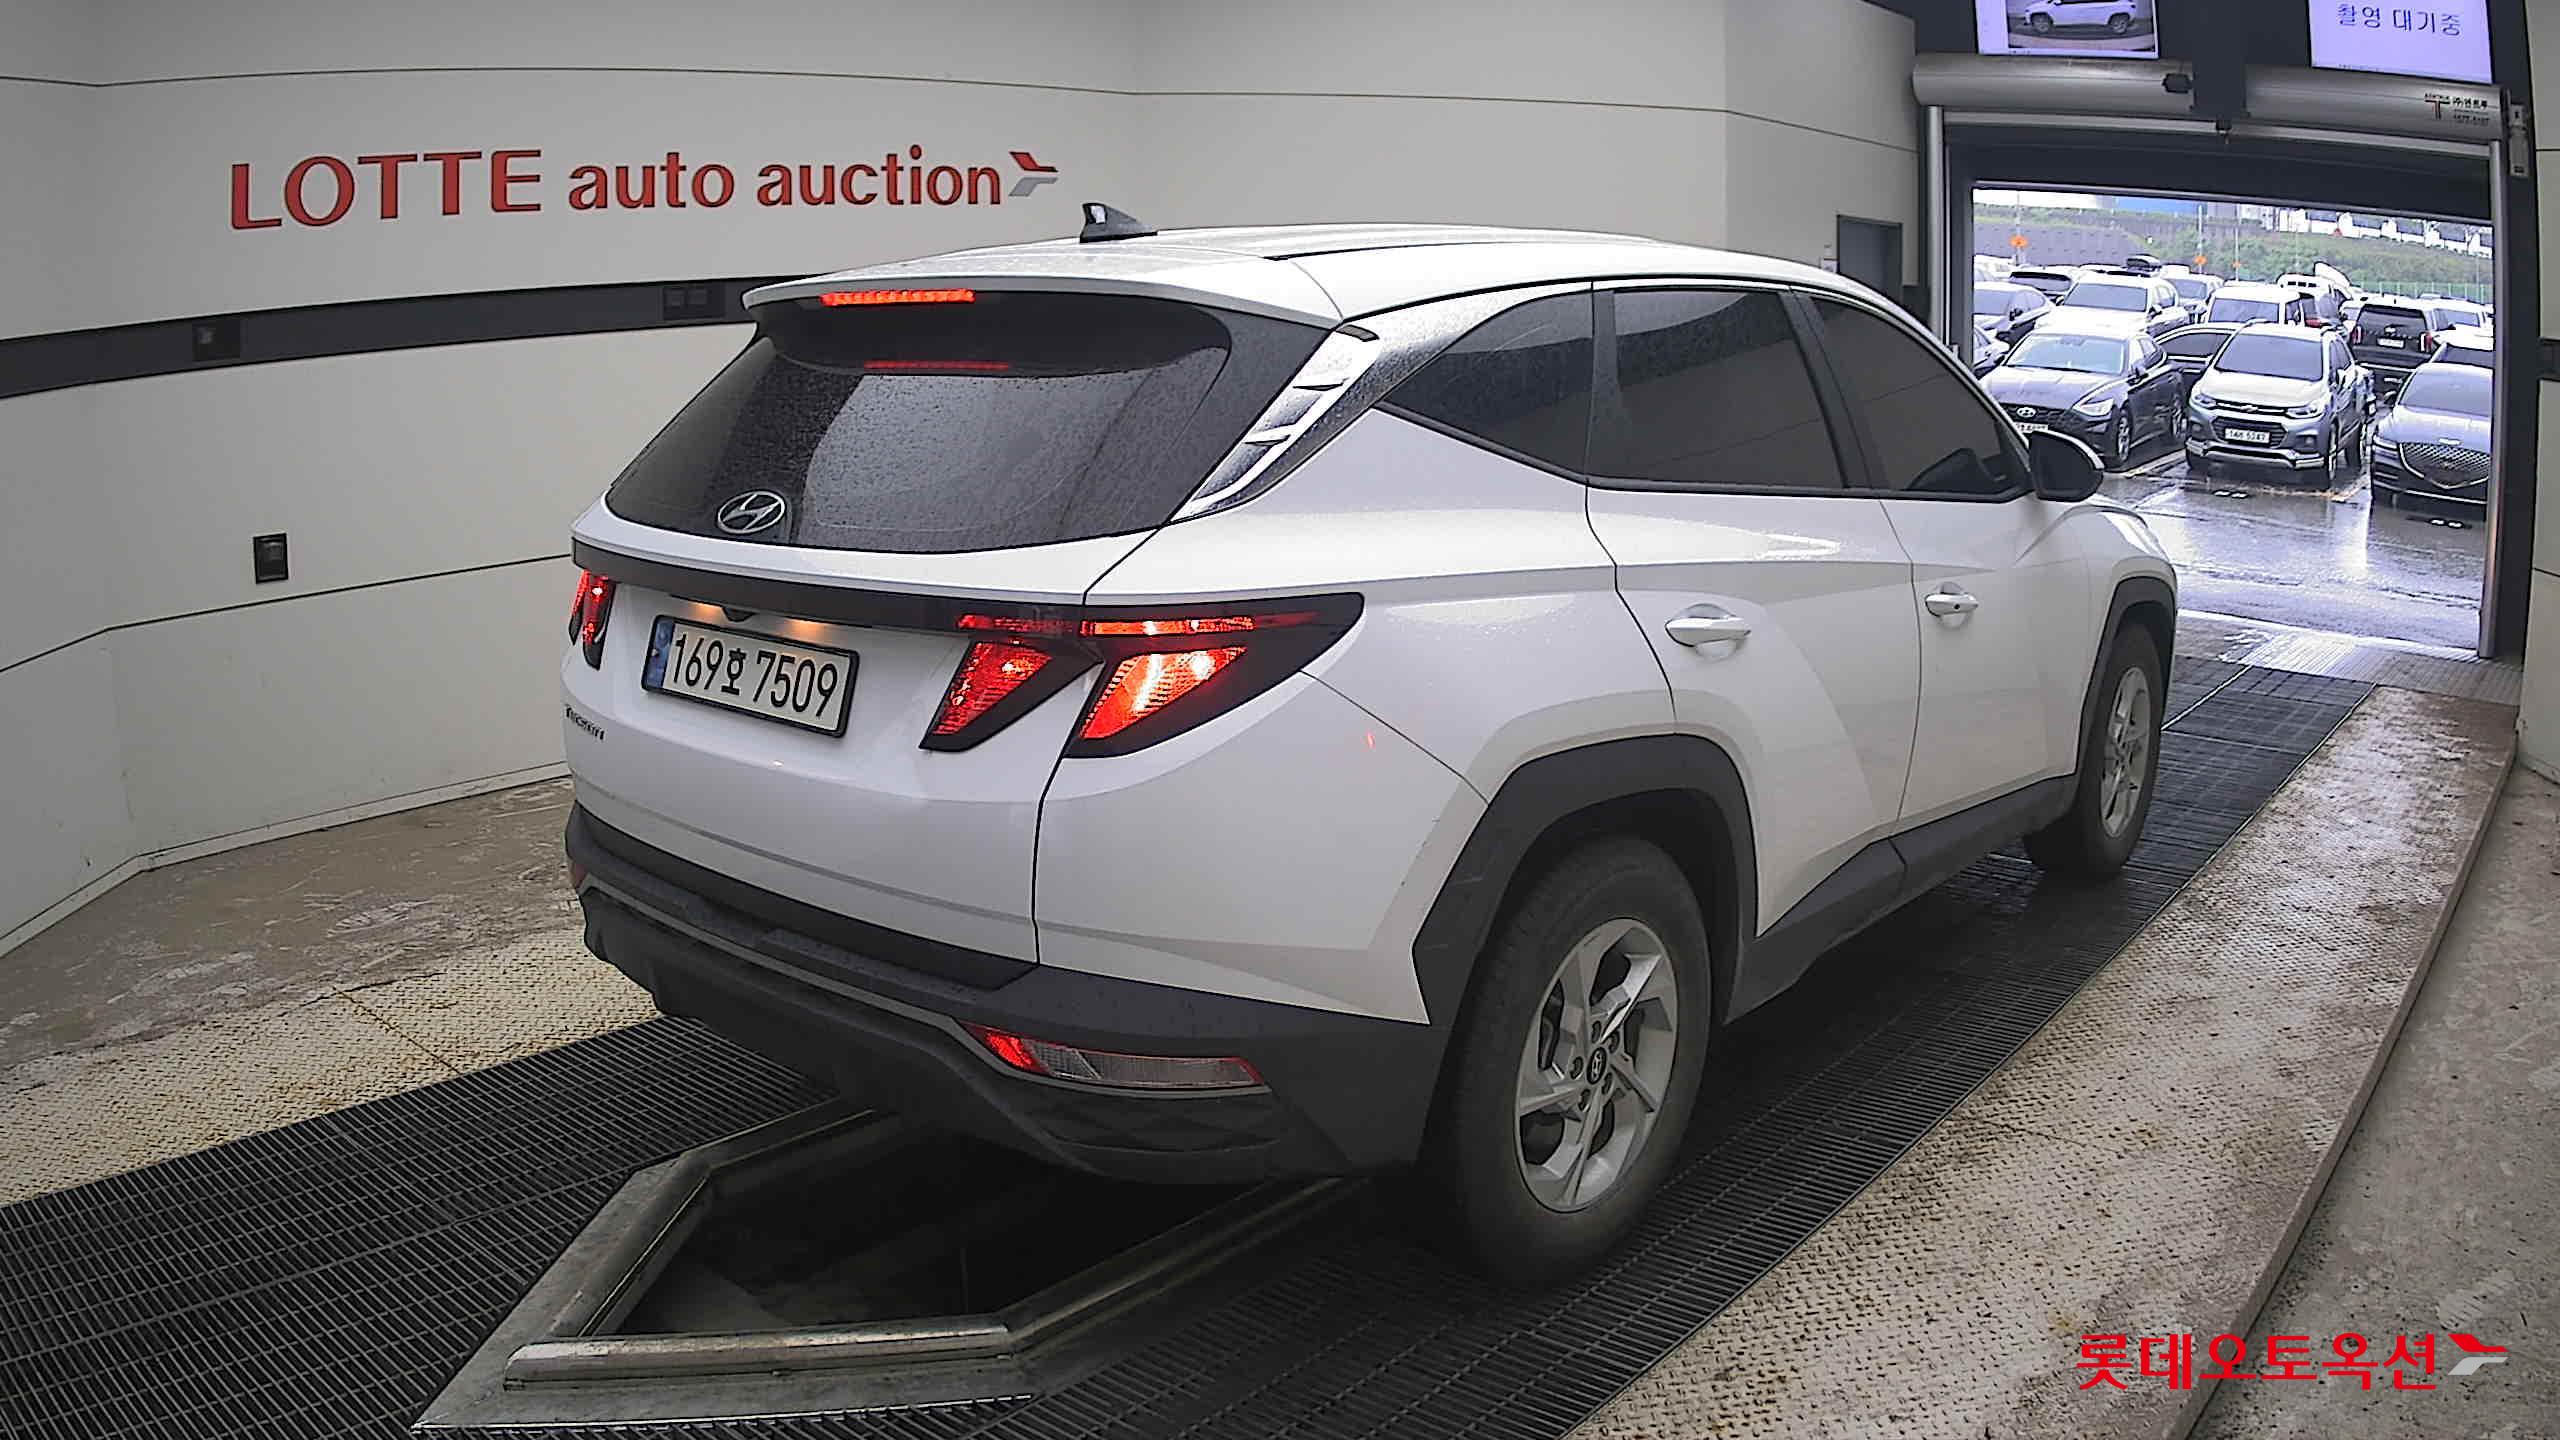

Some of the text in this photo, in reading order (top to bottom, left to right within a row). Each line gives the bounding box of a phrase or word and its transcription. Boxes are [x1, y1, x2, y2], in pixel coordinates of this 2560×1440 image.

[2392, 8, 2461, 37] 대기중
[231, 145, 1002, 231] LOTTE auto auction
[672, 631, 839, 719] 169호 7509
